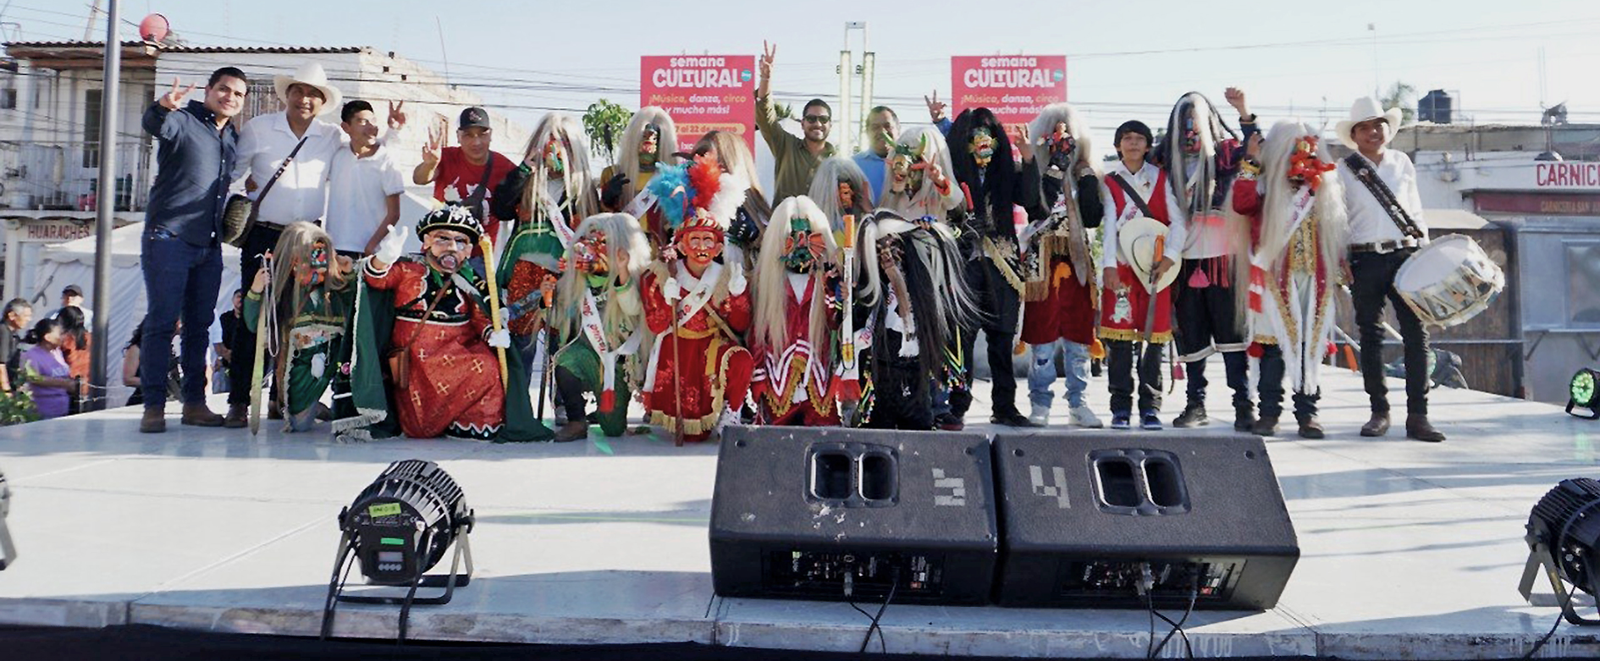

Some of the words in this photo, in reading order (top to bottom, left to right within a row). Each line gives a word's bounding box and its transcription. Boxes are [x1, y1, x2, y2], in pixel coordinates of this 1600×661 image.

[670, 57, 725, 67] semana
[981, 57, 1036, 67] semana
[652, 68, 742, 88] CULTURAL
[964, 68, 1055, 88] CULTURAL
[689, 93, 721, 104] danza,
[723, 94, 746, 103] circo
[1001, 93, 1034, 104] danza,
[672, 105, 706, 114] mucho
[1536, 163, 1600, 186] CARNIC
[28, 224, 91, 240] HUARACHES
